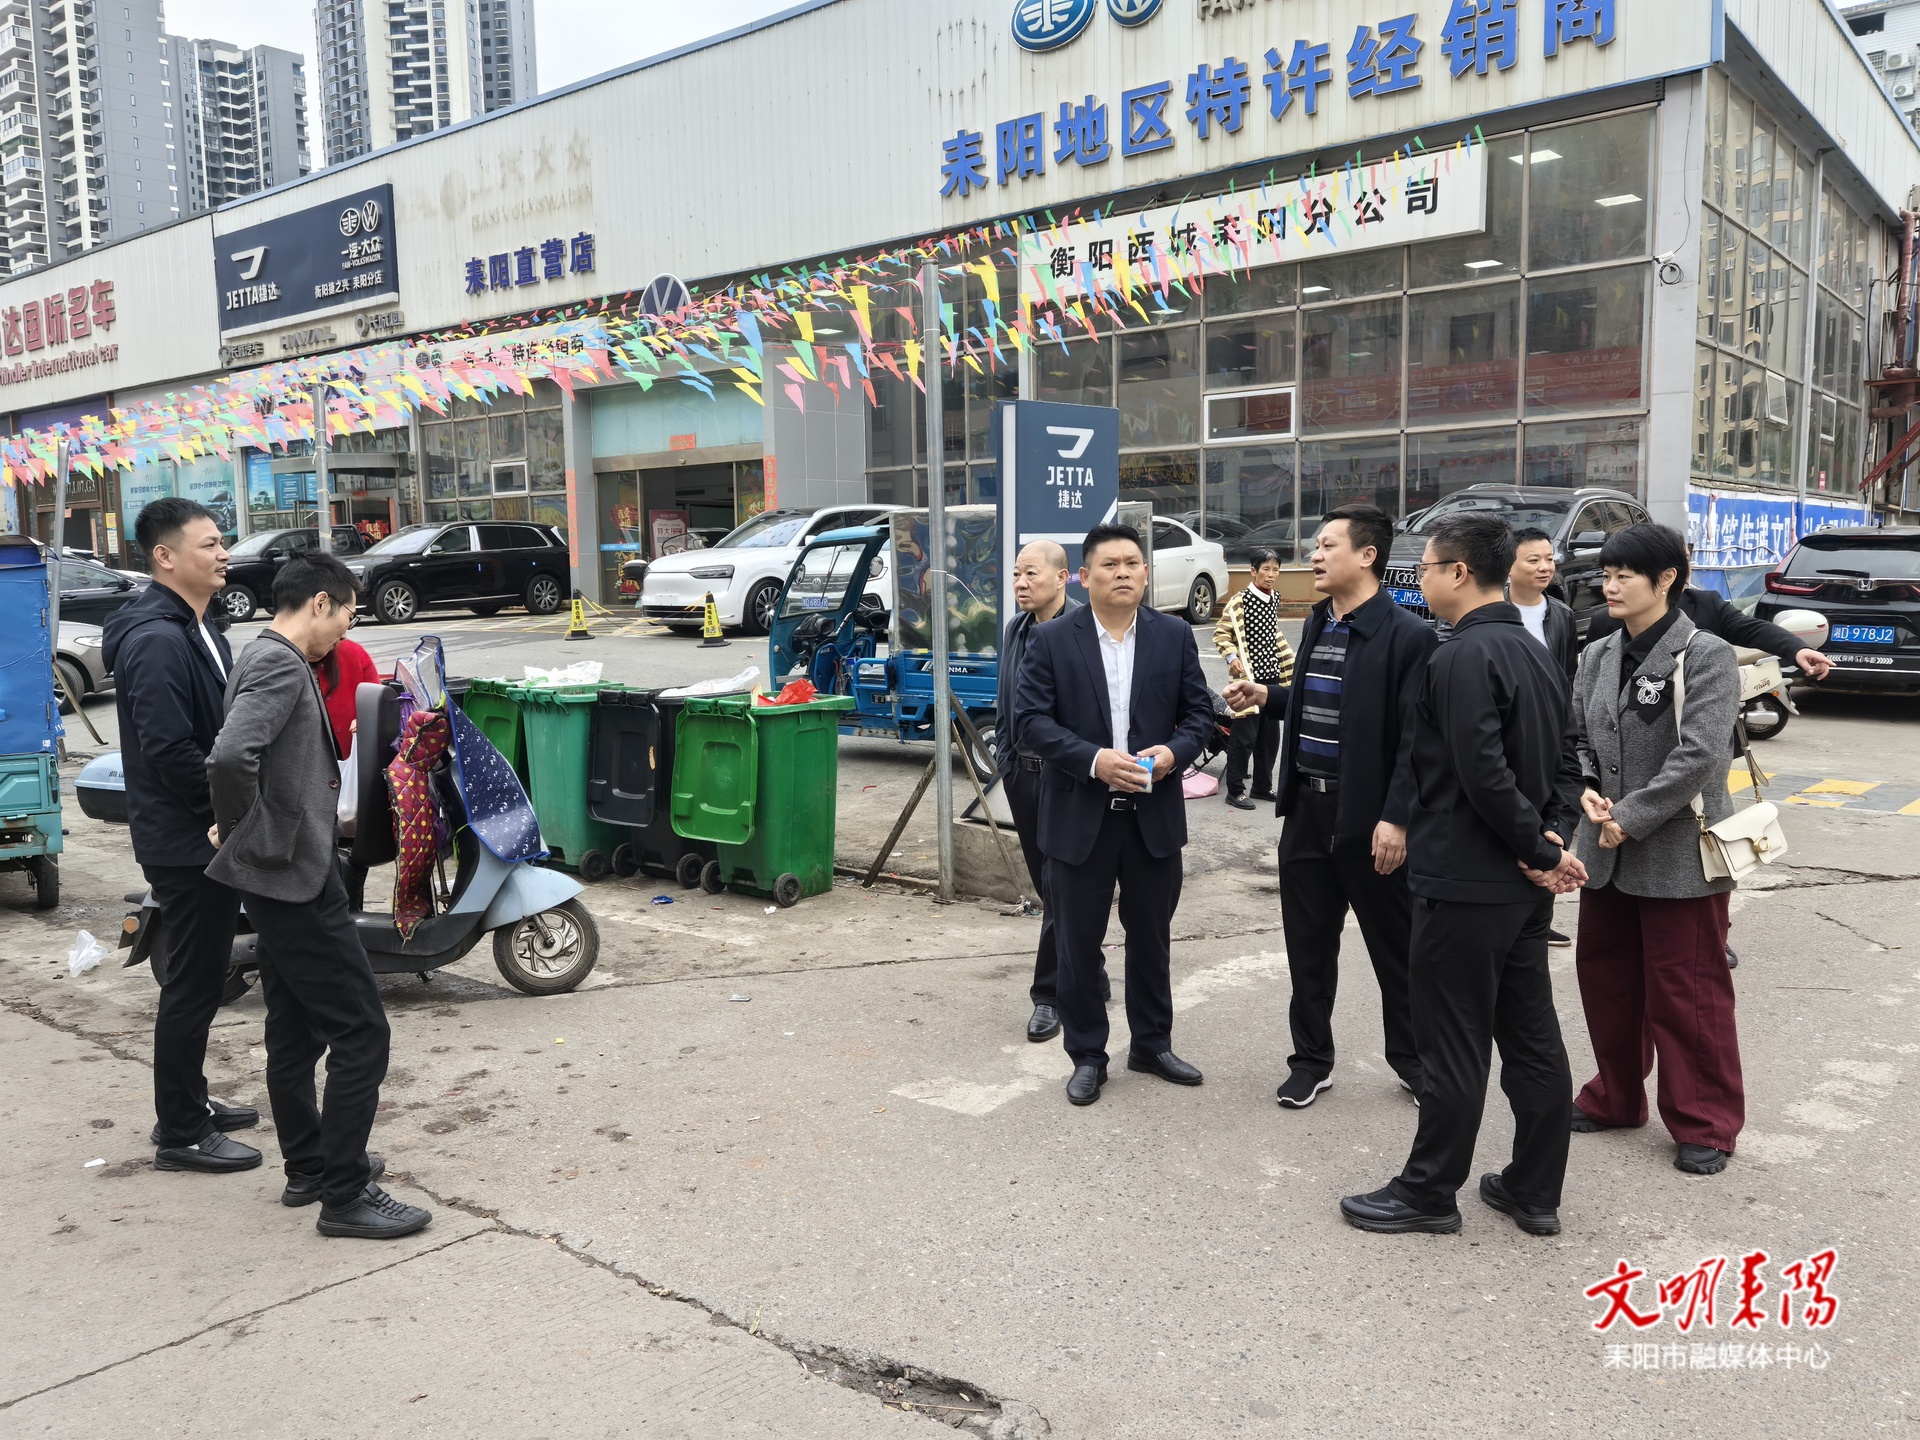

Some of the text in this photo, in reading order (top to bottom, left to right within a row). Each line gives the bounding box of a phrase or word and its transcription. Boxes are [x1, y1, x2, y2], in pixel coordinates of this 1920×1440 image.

[938, 0, 1615, 198] 耒阳地区特许经销商
[1049, 177, 1440, 279] 衡阳西城耒阳分公司
[464, 231, 595, 295] 耒阳直营店
[315, 270, 383, 299] 衡阳捷之兴 耒阳分店
[0, 279, 116, 358] 达国际名车
[99, 343, 118, 361] car
[280, 326, 336, 349] HAVAL
[1046, 466, 1094, 487] JETTA
[1058, 489, 1083, 509] 捷达
